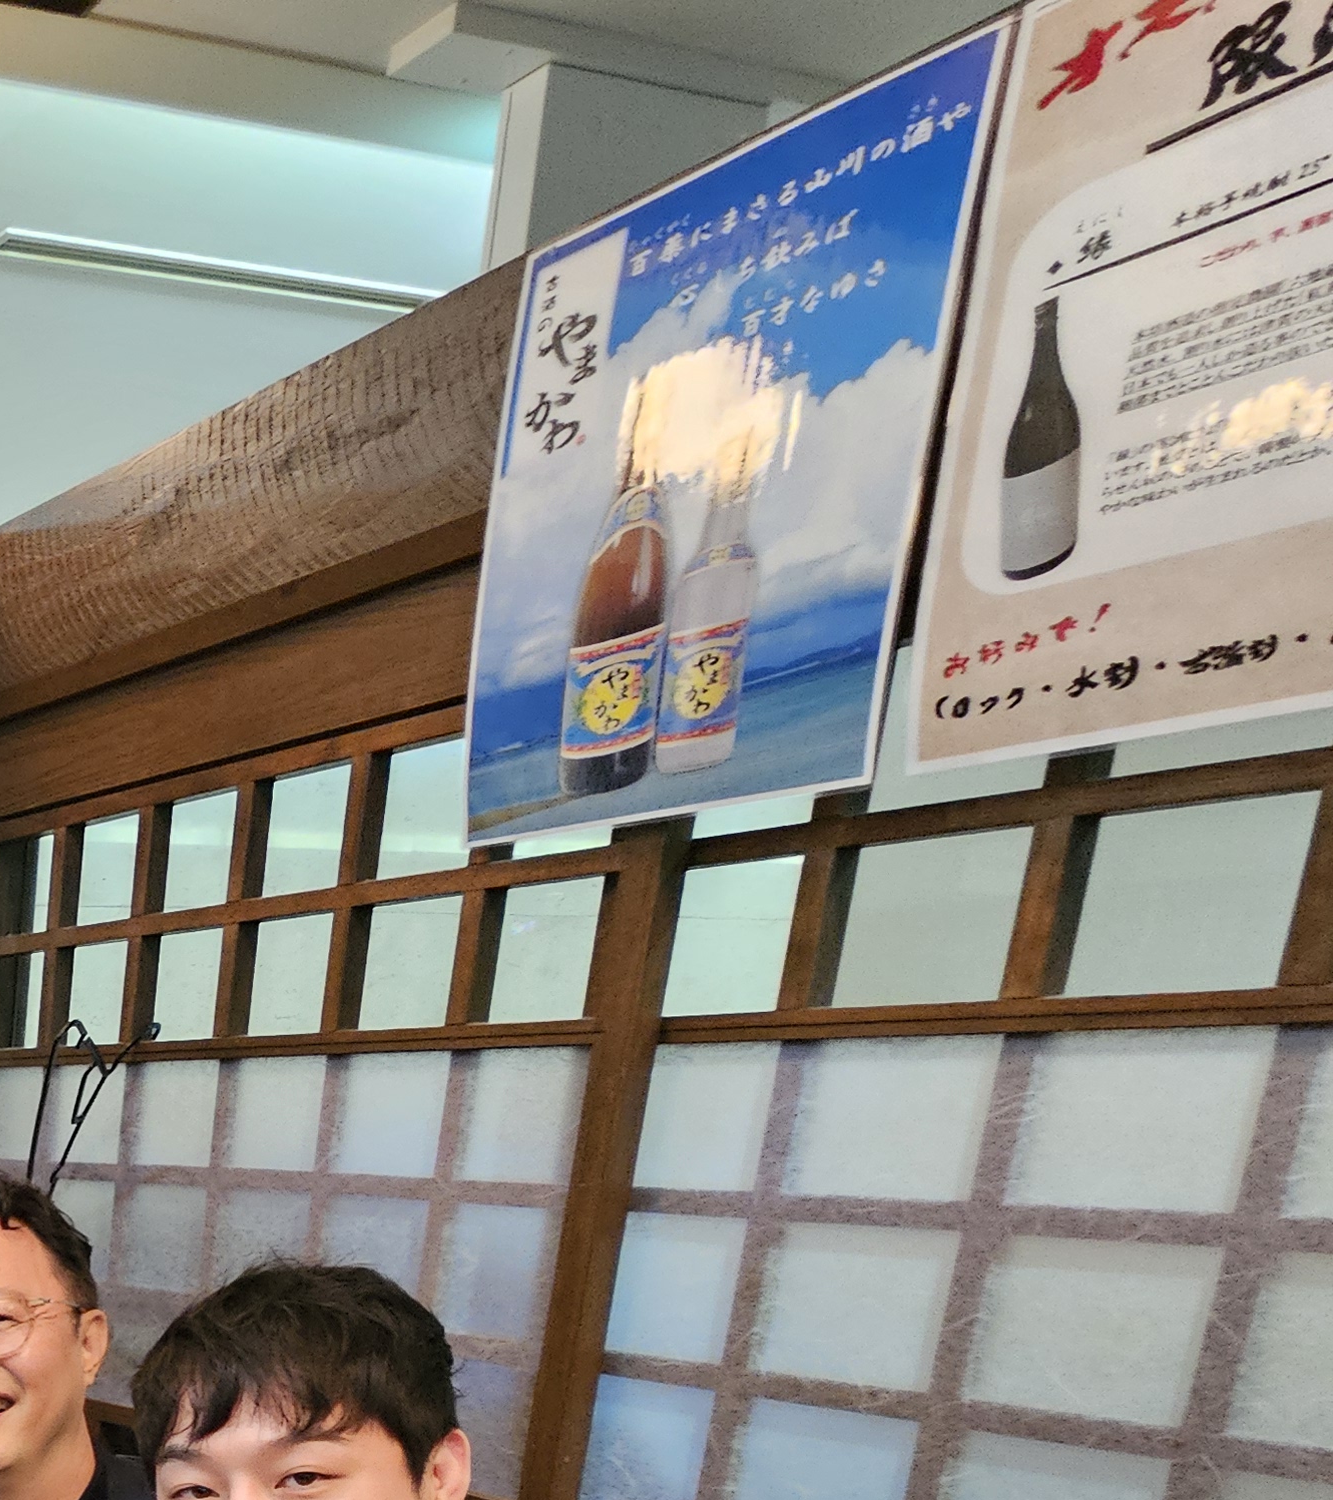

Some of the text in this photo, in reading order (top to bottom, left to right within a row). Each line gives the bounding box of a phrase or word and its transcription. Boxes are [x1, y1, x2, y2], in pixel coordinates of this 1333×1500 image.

[1198, 0, 1333, 111] 限
[525, 312, 598, 455] やまかわ
